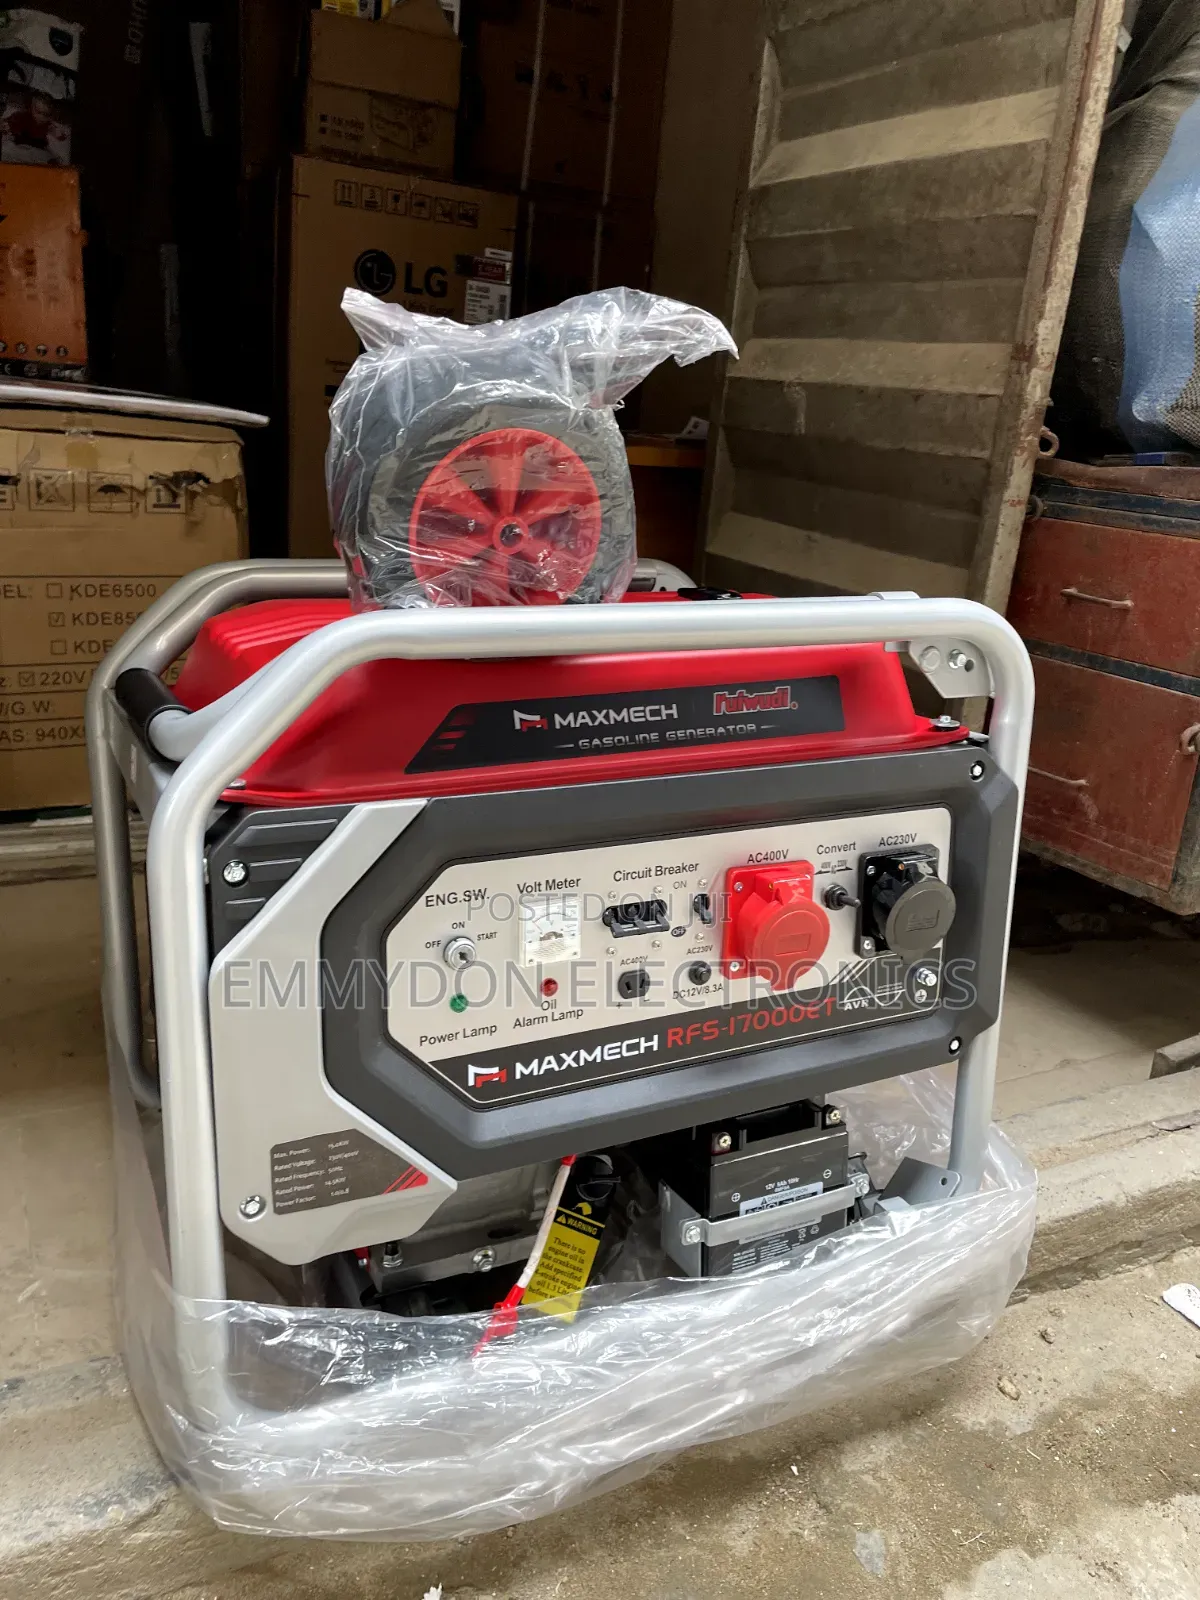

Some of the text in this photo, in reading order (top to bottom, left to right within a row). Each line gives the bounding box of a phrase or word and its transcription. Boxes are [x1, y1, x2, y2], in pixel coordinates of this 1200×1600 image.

[404, 262, 448, 298] LG
[0, 583, 157, 599] EL: KDE6500
[73, 639, 114, 654] KDE
[40, 670, 86, 686] 220V
[553, 703, 679, 730] MAXMECH
[0, 725, 86, 744] AS: 940X
[578, 724, 757, 750] GASOLINE GENERATOR
[878, 832, 918, 848] AC230V
[747, 848, 789, 864] AC400V
[816, 841, 857, 856] Convert
[613, 862, 700, 882] Circuit Breaker
[516, 877, 581, 895] Volt Meter
[673, 880, 687, 890] ON
[425, 887, 490, 908] ENG.SW.
[451, 921, 466, 930] ON
[672, 928, 685, 937] OFF
[477, 931, 498, 941] START
[425, 940, 442, 949] OFF
[686, 944, 714, 956] AC230V
[672, 983, 724, 1000] DC12V/8.3A
[541, 999, 557, 1011] Oil
[844, 999, 869, 1011] AVR
[513, 1008, 584, 1029] Alarm Lamp
[419, 1024, 498, 1047] Power Lamp
[514, 1035, 659, 1079] MAXMECH
[567, 1217, 598, 1235] WARNING
[553, 1236, 571, 1249] There
[548, 1246, 568, 1258] engine
